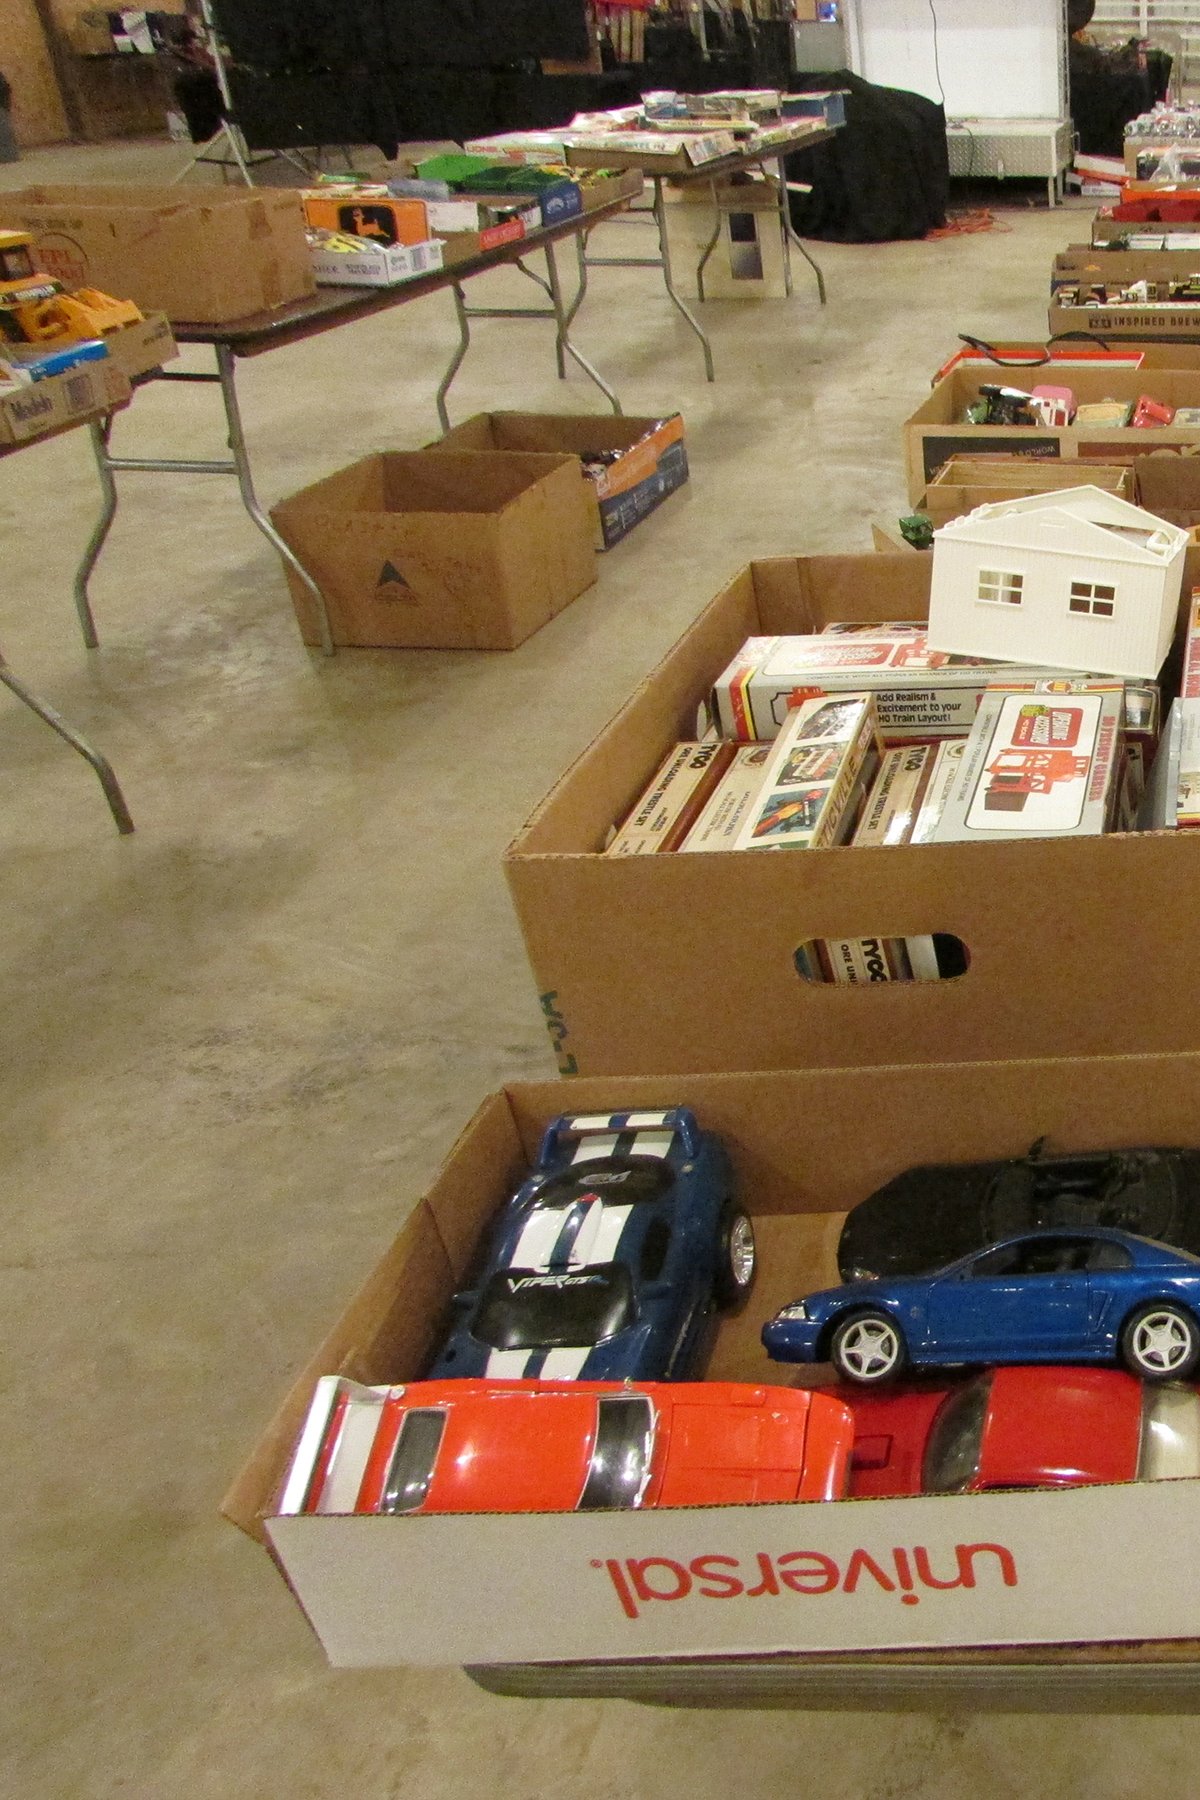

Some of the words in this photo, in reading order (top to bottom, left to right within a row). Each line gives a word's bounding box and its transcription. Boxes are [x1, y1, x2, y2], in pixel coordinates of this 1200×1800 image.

[1114, 316, 1165, 327] INSPIRED
[876, 693, 894, 702] Add
[896, 693, 929, 702] Realism
[930, 692, 936, 701] &
[877, 703, 927, 713] Excitement
[930, 703, 940, 712] to
[941, 702, 962, 713] your
[879, 714, 891, 723] HO
[893, 714, 915, 723] Train
[917, 713, 951, 724] Layout!
[689, 744, 718, 769] TYCO
[903, 747, 927, 771] TYCO
[640, 792, 664, 815] TRESTLE
[634, 816, 648, 827] SET
[841, 944, 853, 964] ORE
[507, 1274, 571, 1293] VIPER
[605, 1543, 1018, 1619] universal
